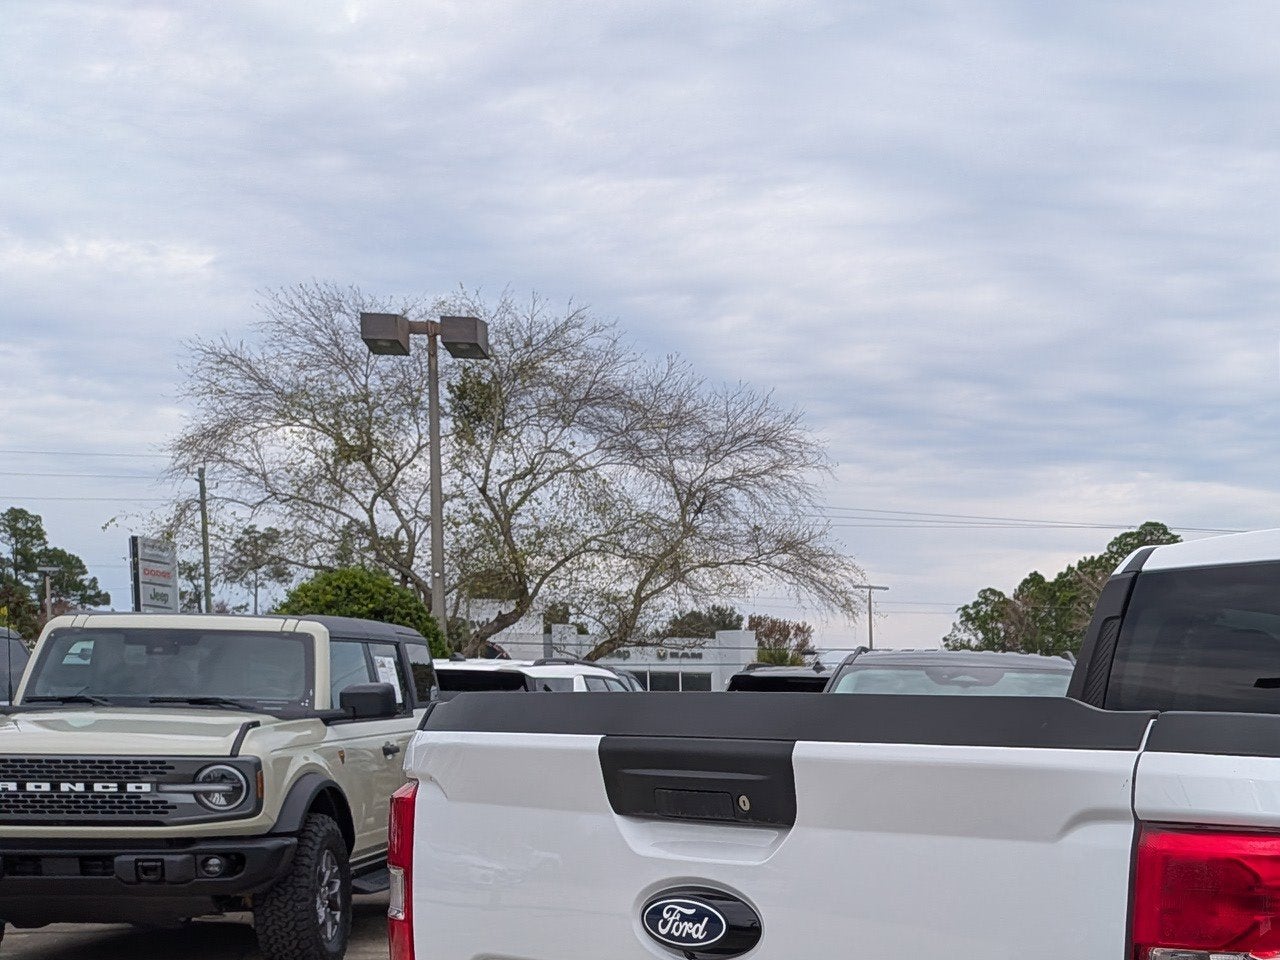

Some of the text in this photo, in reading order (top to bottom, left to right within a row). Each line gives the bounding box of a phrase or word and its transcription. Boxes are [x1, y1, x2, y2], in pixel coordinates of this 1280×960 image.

[149, 587, 169, 604] Jeep
[669, 651, 703, 659] RAM
[0, 781, 151, 792] RONCO
[658, 904, 709, 940] Ford
